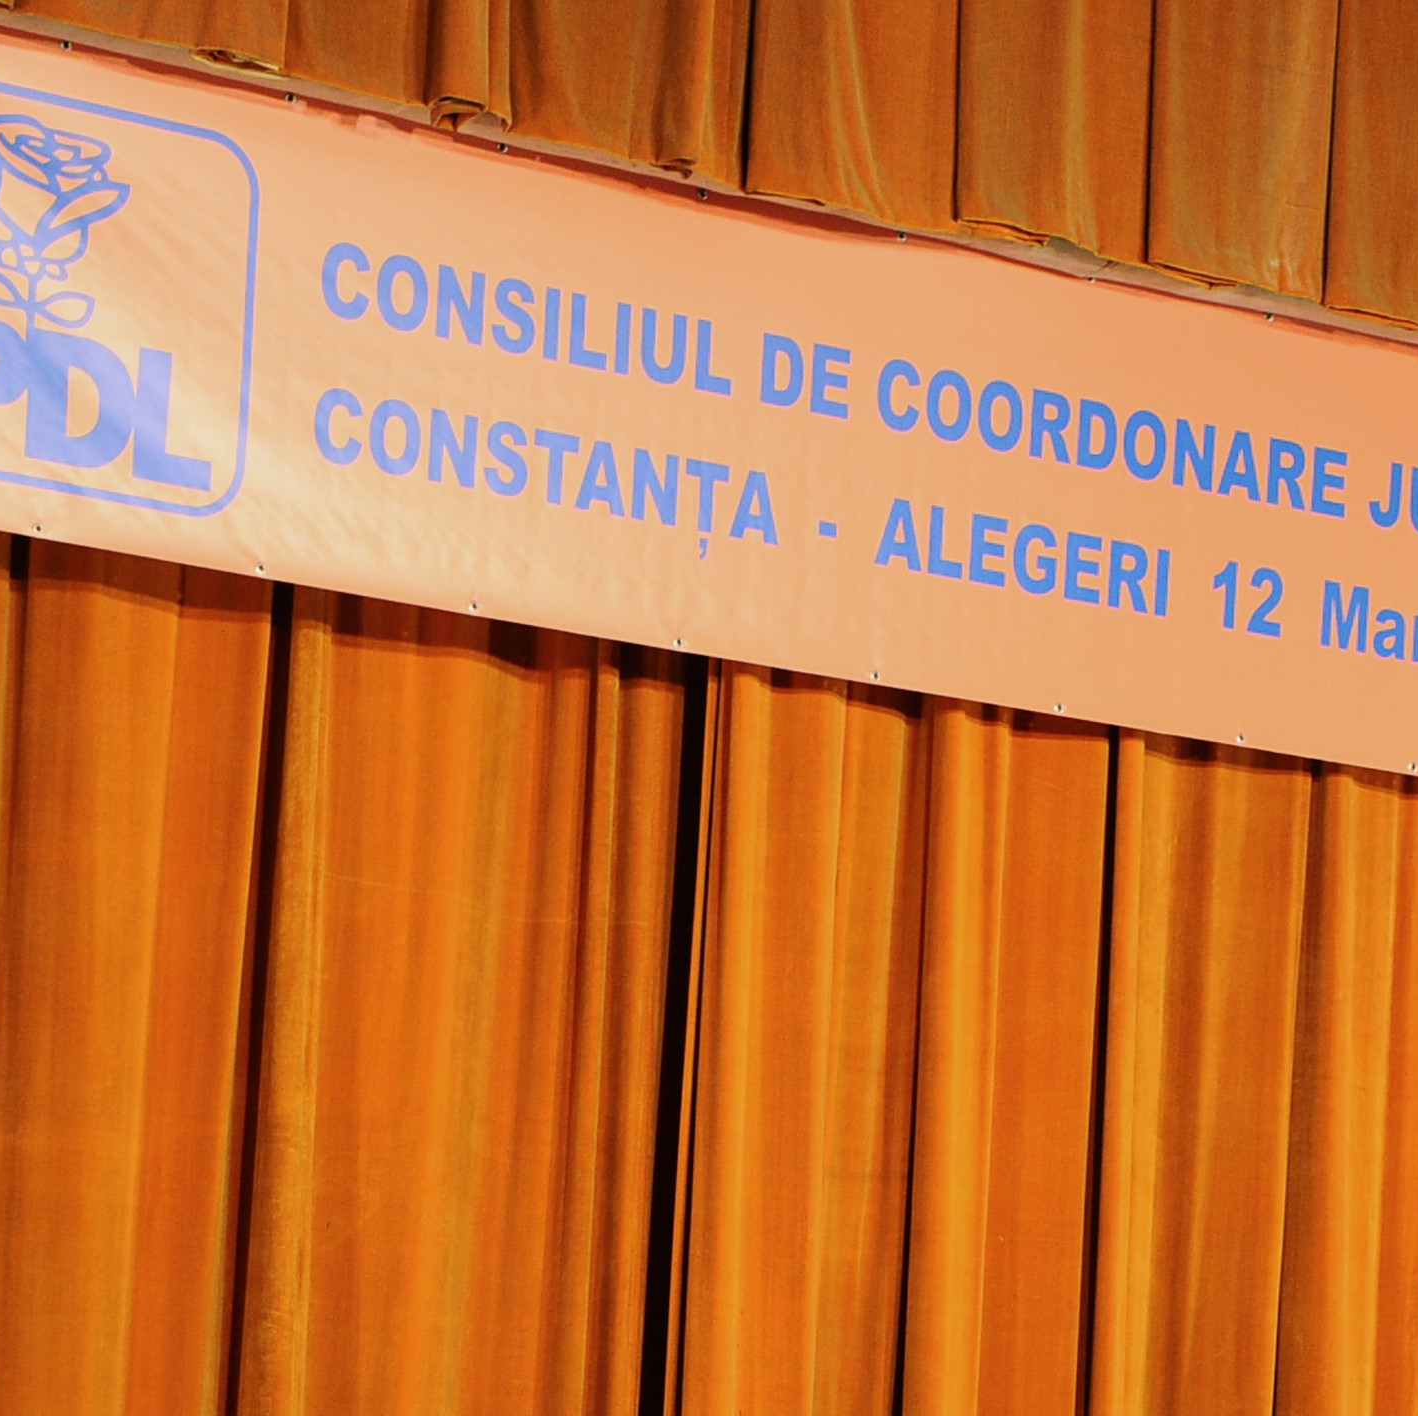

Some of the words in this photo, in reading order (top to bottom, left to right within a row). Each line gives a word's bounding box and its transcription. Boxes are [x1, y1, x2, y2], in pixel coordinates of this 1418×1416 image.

[321, 242, 733, 396] CONSILIUL
[760, 332, 852, 420] DE
[877, 359, 1349, 519] COORDONARE
[314, 388, 779, 560] CONSTANȚA
[818, 521, 838, 538] -
[874, 498, 1172, 617] ALEGERI
[1212, 560, 1284, 638] 12
